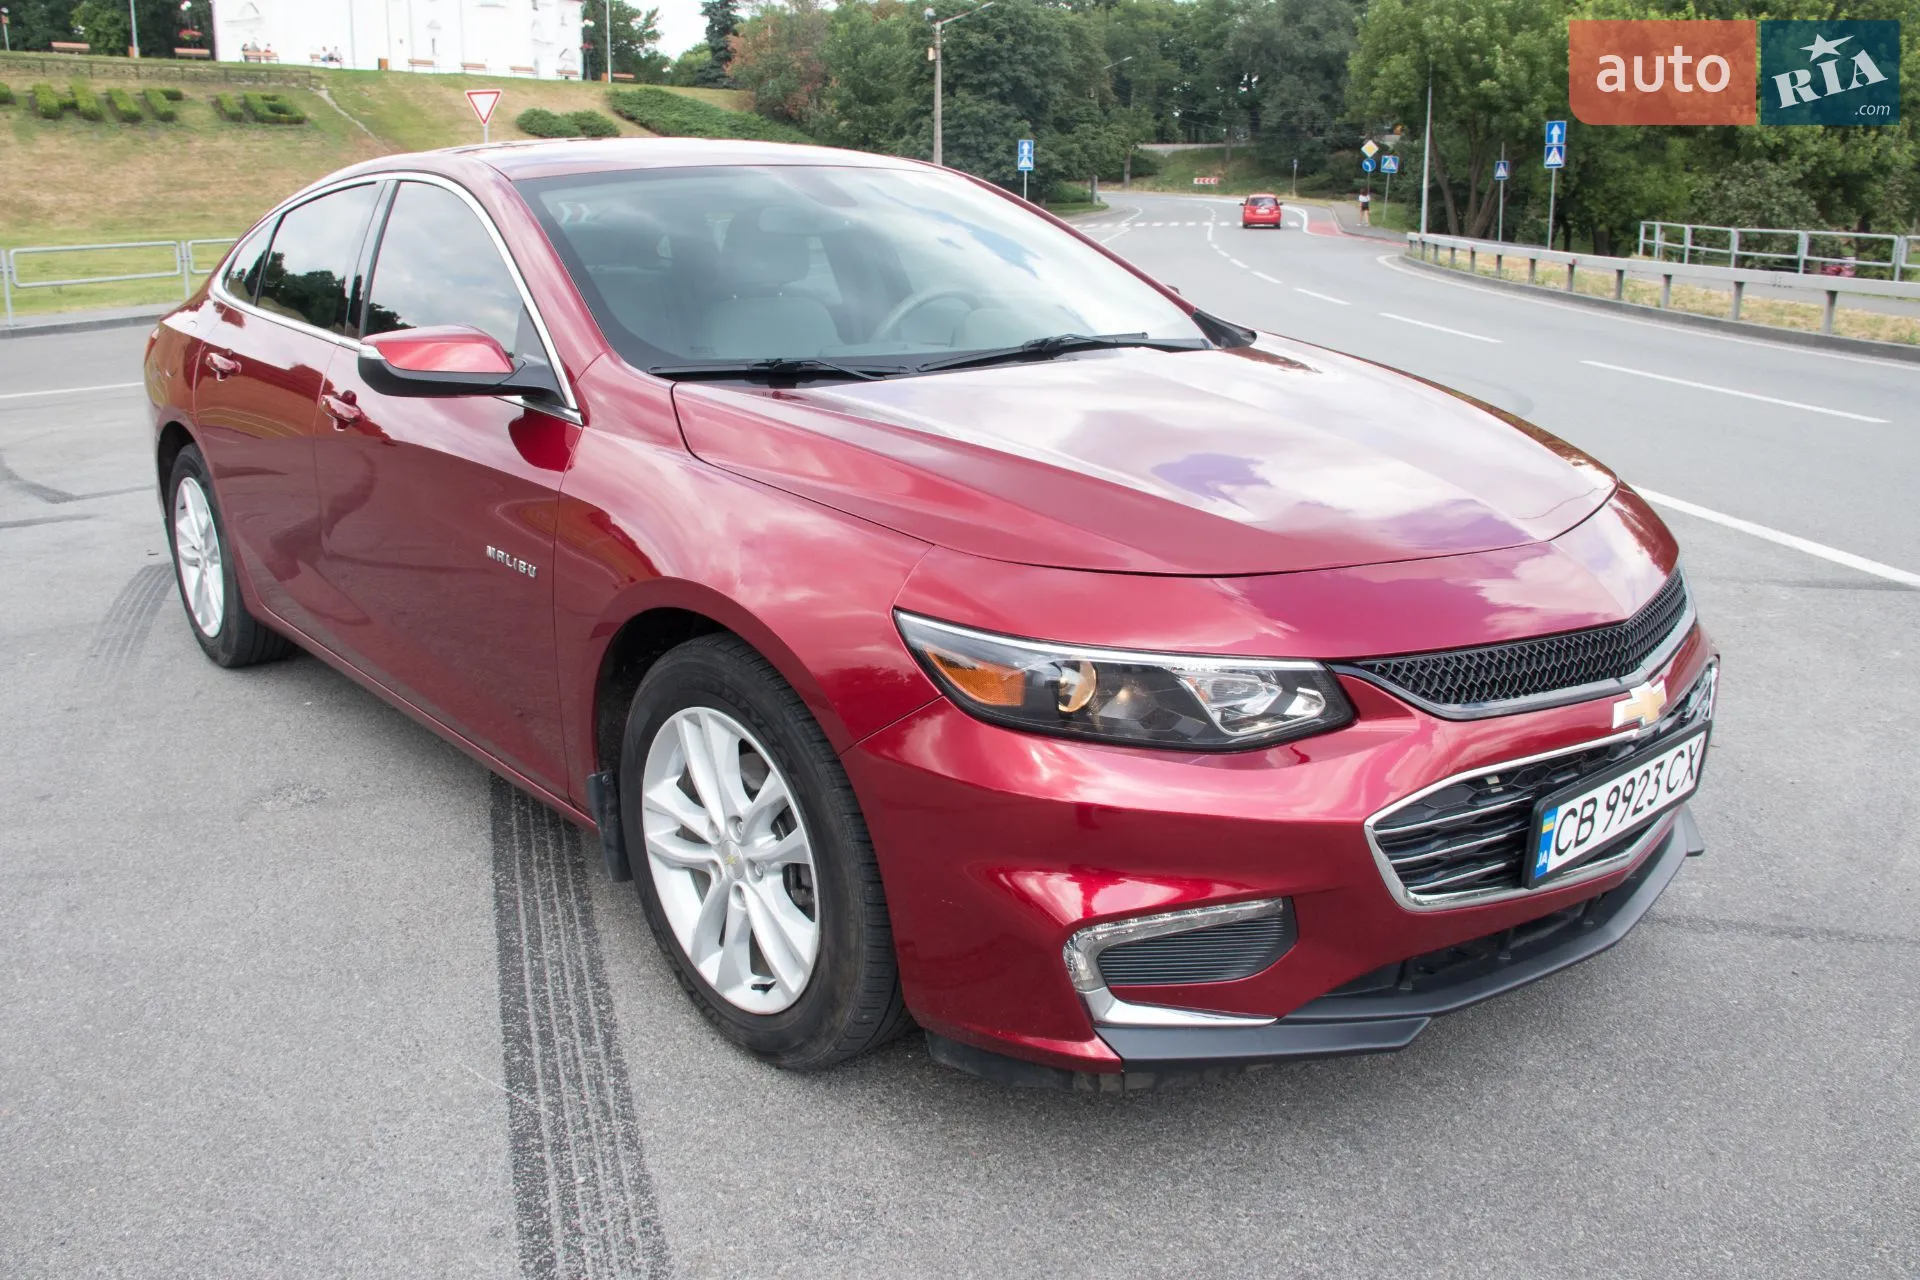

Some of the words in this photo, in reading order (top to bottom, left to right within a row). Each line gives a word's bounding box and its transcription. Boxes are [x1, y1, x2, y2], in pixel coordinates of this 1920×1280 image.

[485, 544, 537, 579] MALIBU
[1554, 796, 1598, 857] CB
[1602, 760, 1665, 834] 9923
[1665, 737, 1703, 795] CX
